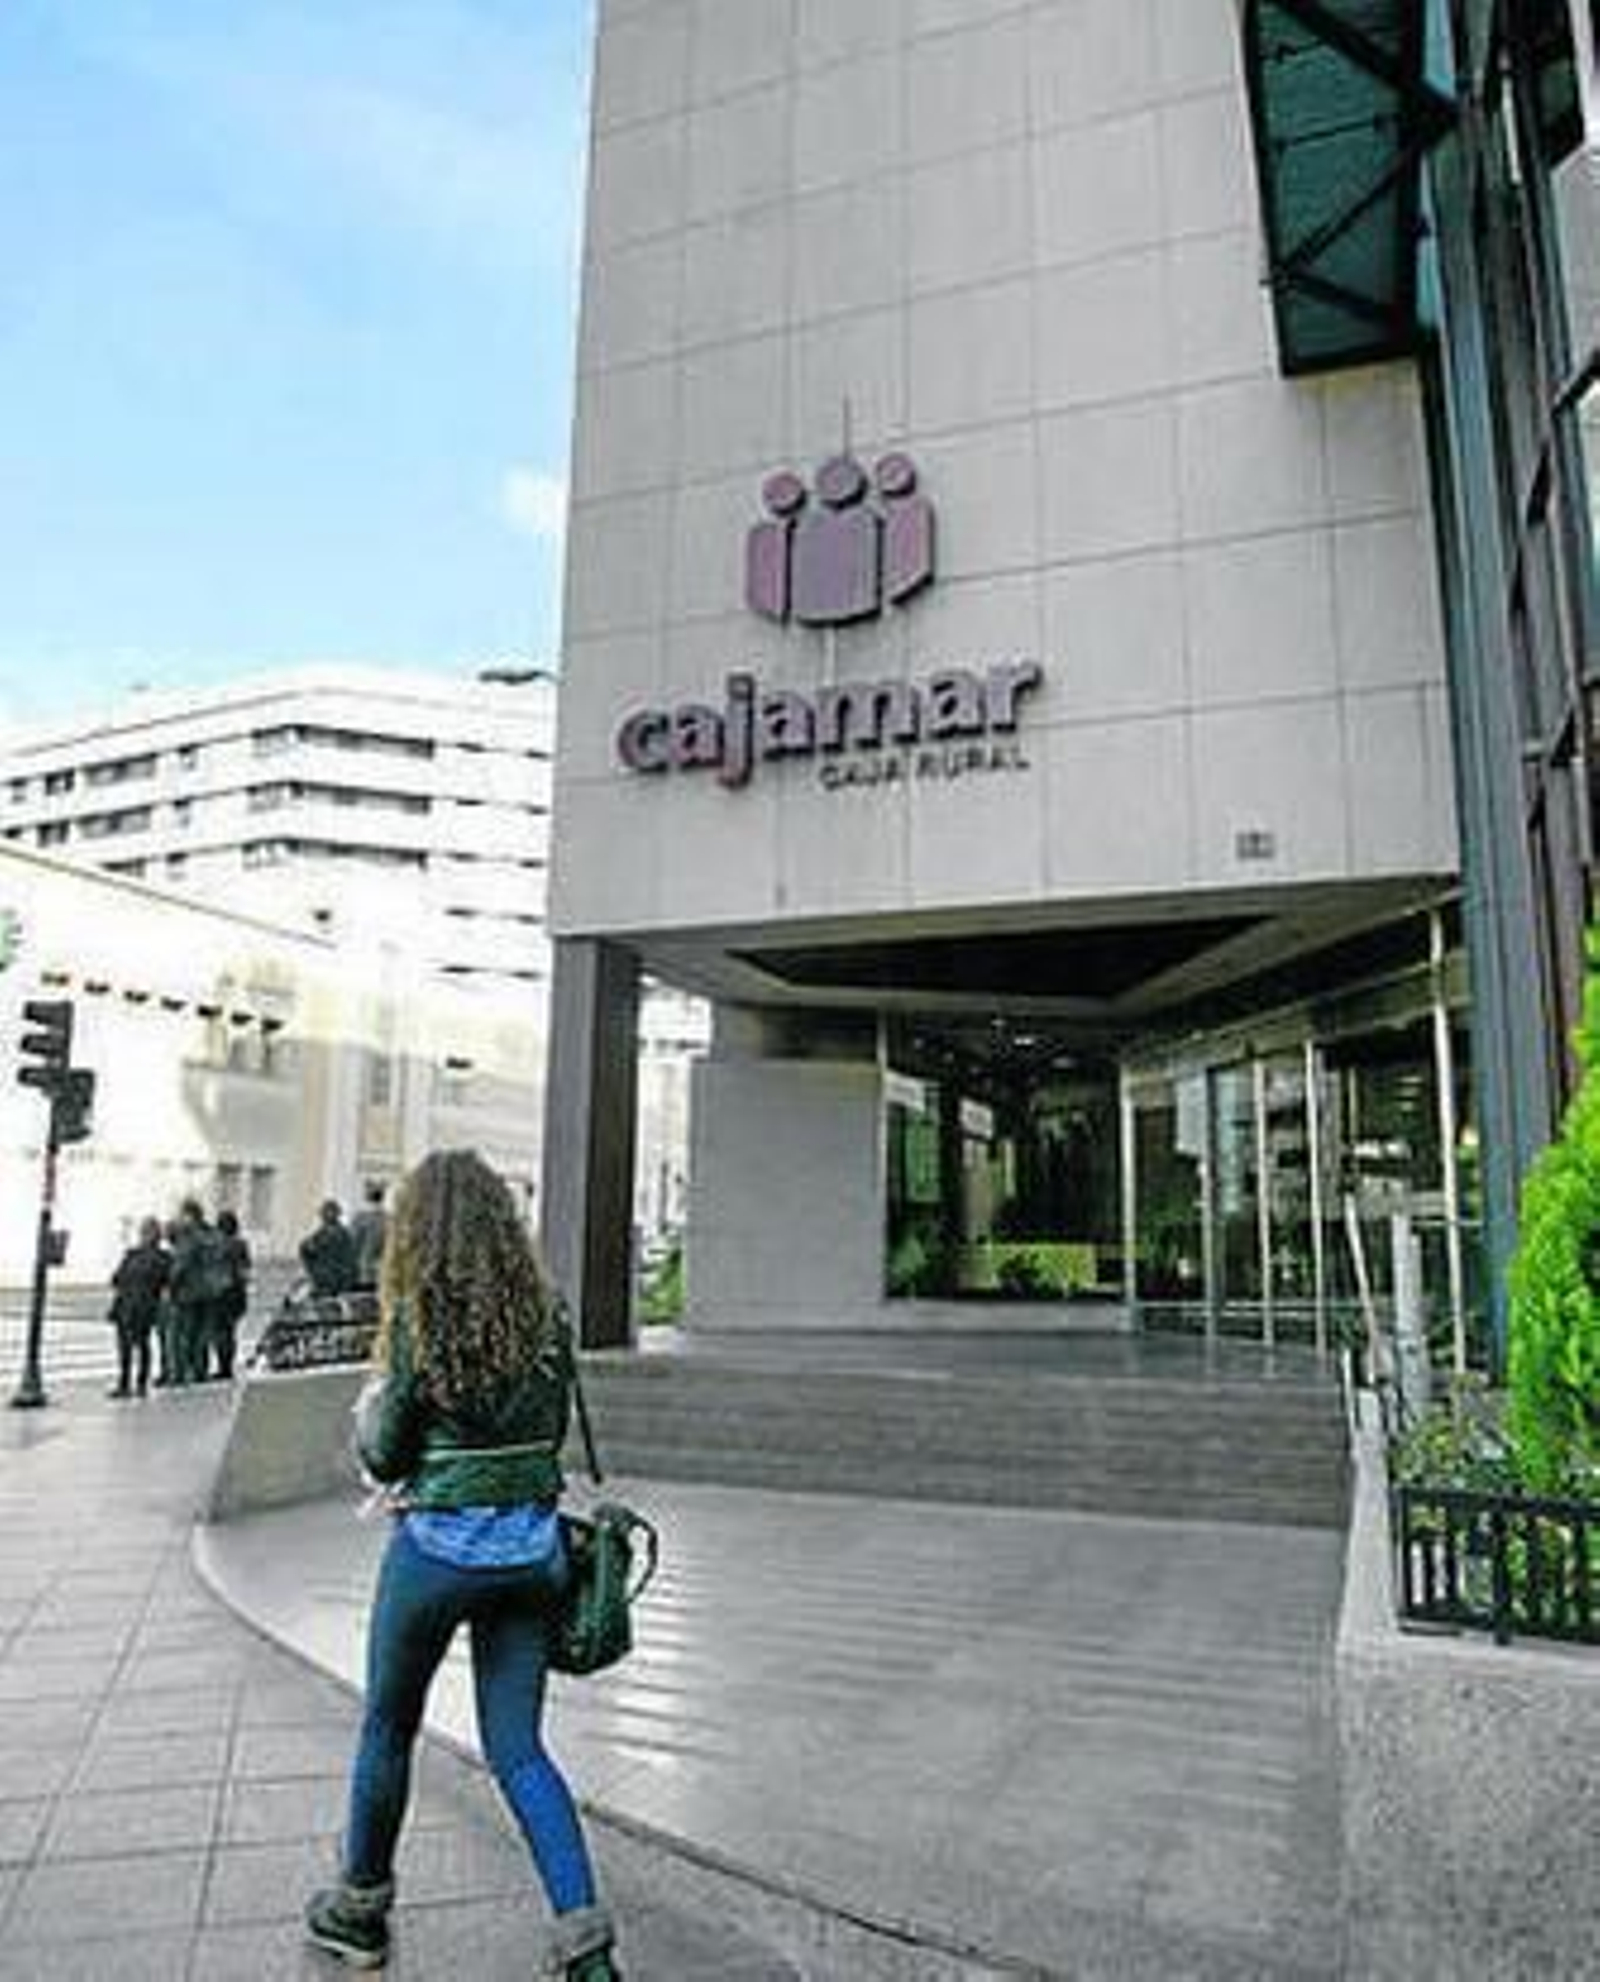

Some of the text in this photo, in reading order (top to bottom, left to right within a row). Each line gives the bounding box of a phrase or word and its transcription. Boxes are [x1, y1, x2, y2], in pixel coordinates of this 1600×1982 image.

[617, 664, 1043, 790] cajamar
[820, 746, 1031, 791] CAJA RURAL
